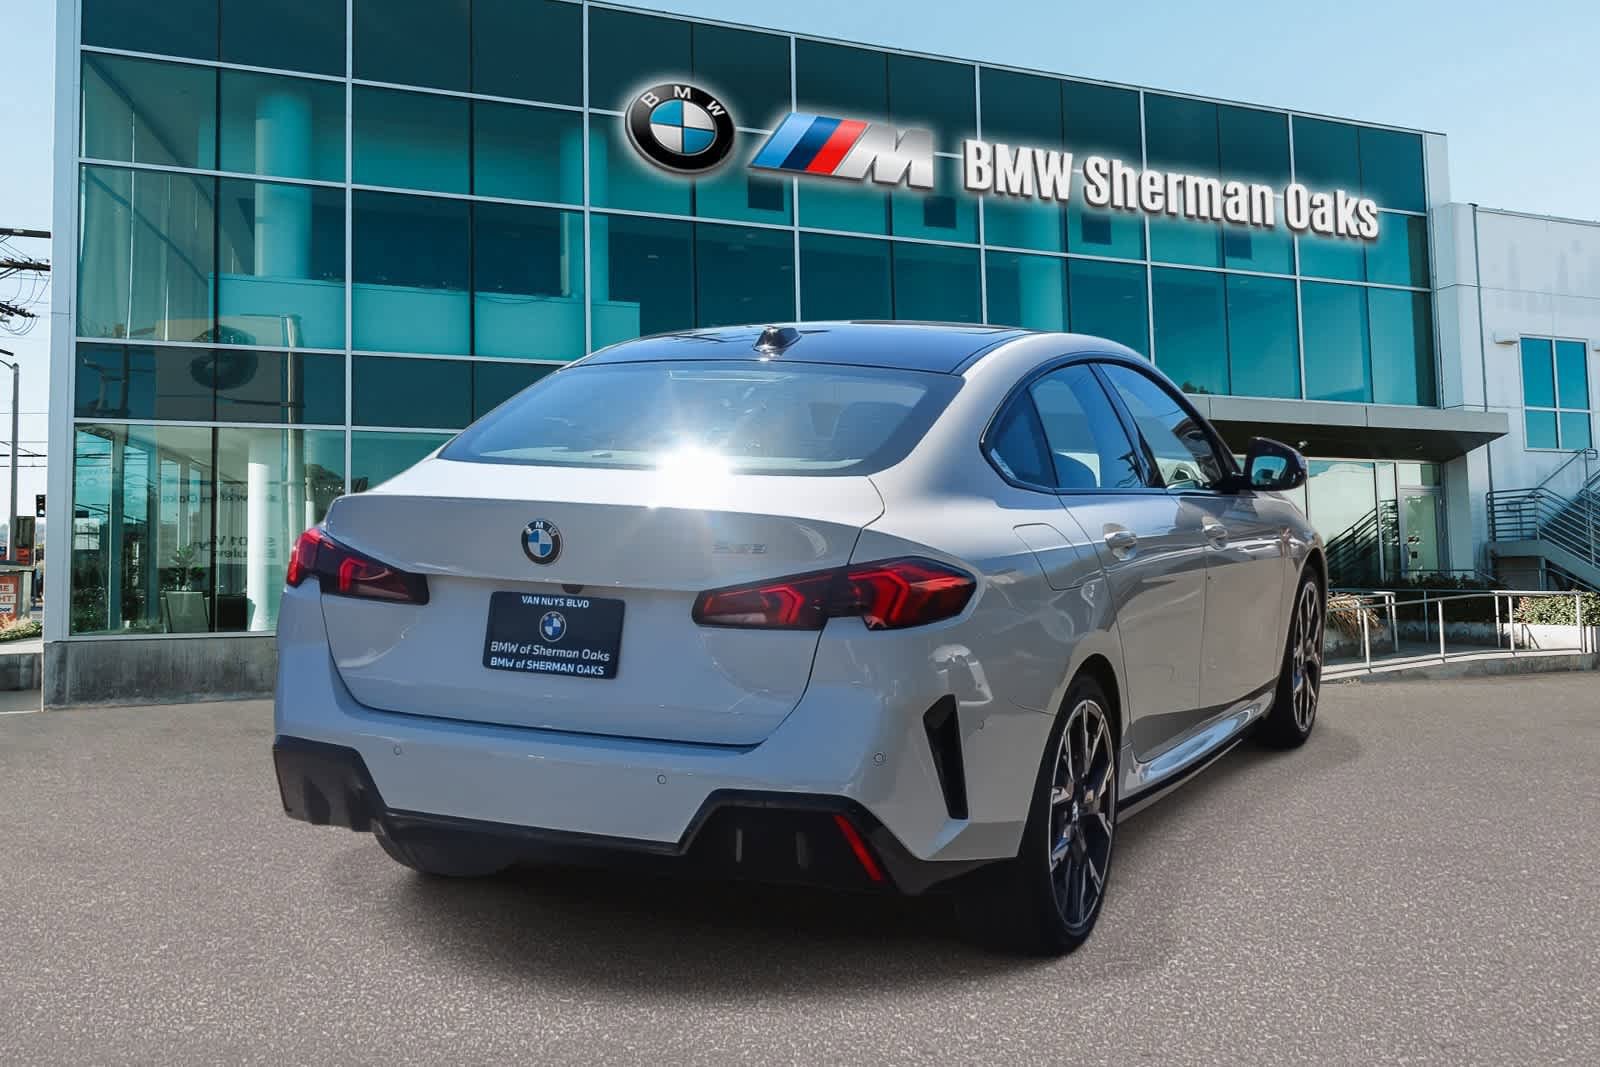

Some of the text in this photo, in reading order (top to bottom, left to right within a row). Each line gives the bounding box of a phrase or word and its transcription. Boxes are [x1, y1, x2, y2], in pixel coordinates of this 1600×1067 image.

[641, 85, 726, 118] BMW
[963, 138, 1380, 241] BMW Sherman Oaks
[521, 595, 590, 608] VAN NUYS BLVD
[490, 641, 610, 662] BMW of Sherman Oaks
[490, 657, 605, 676] BMW of SHERMAN OAKS
